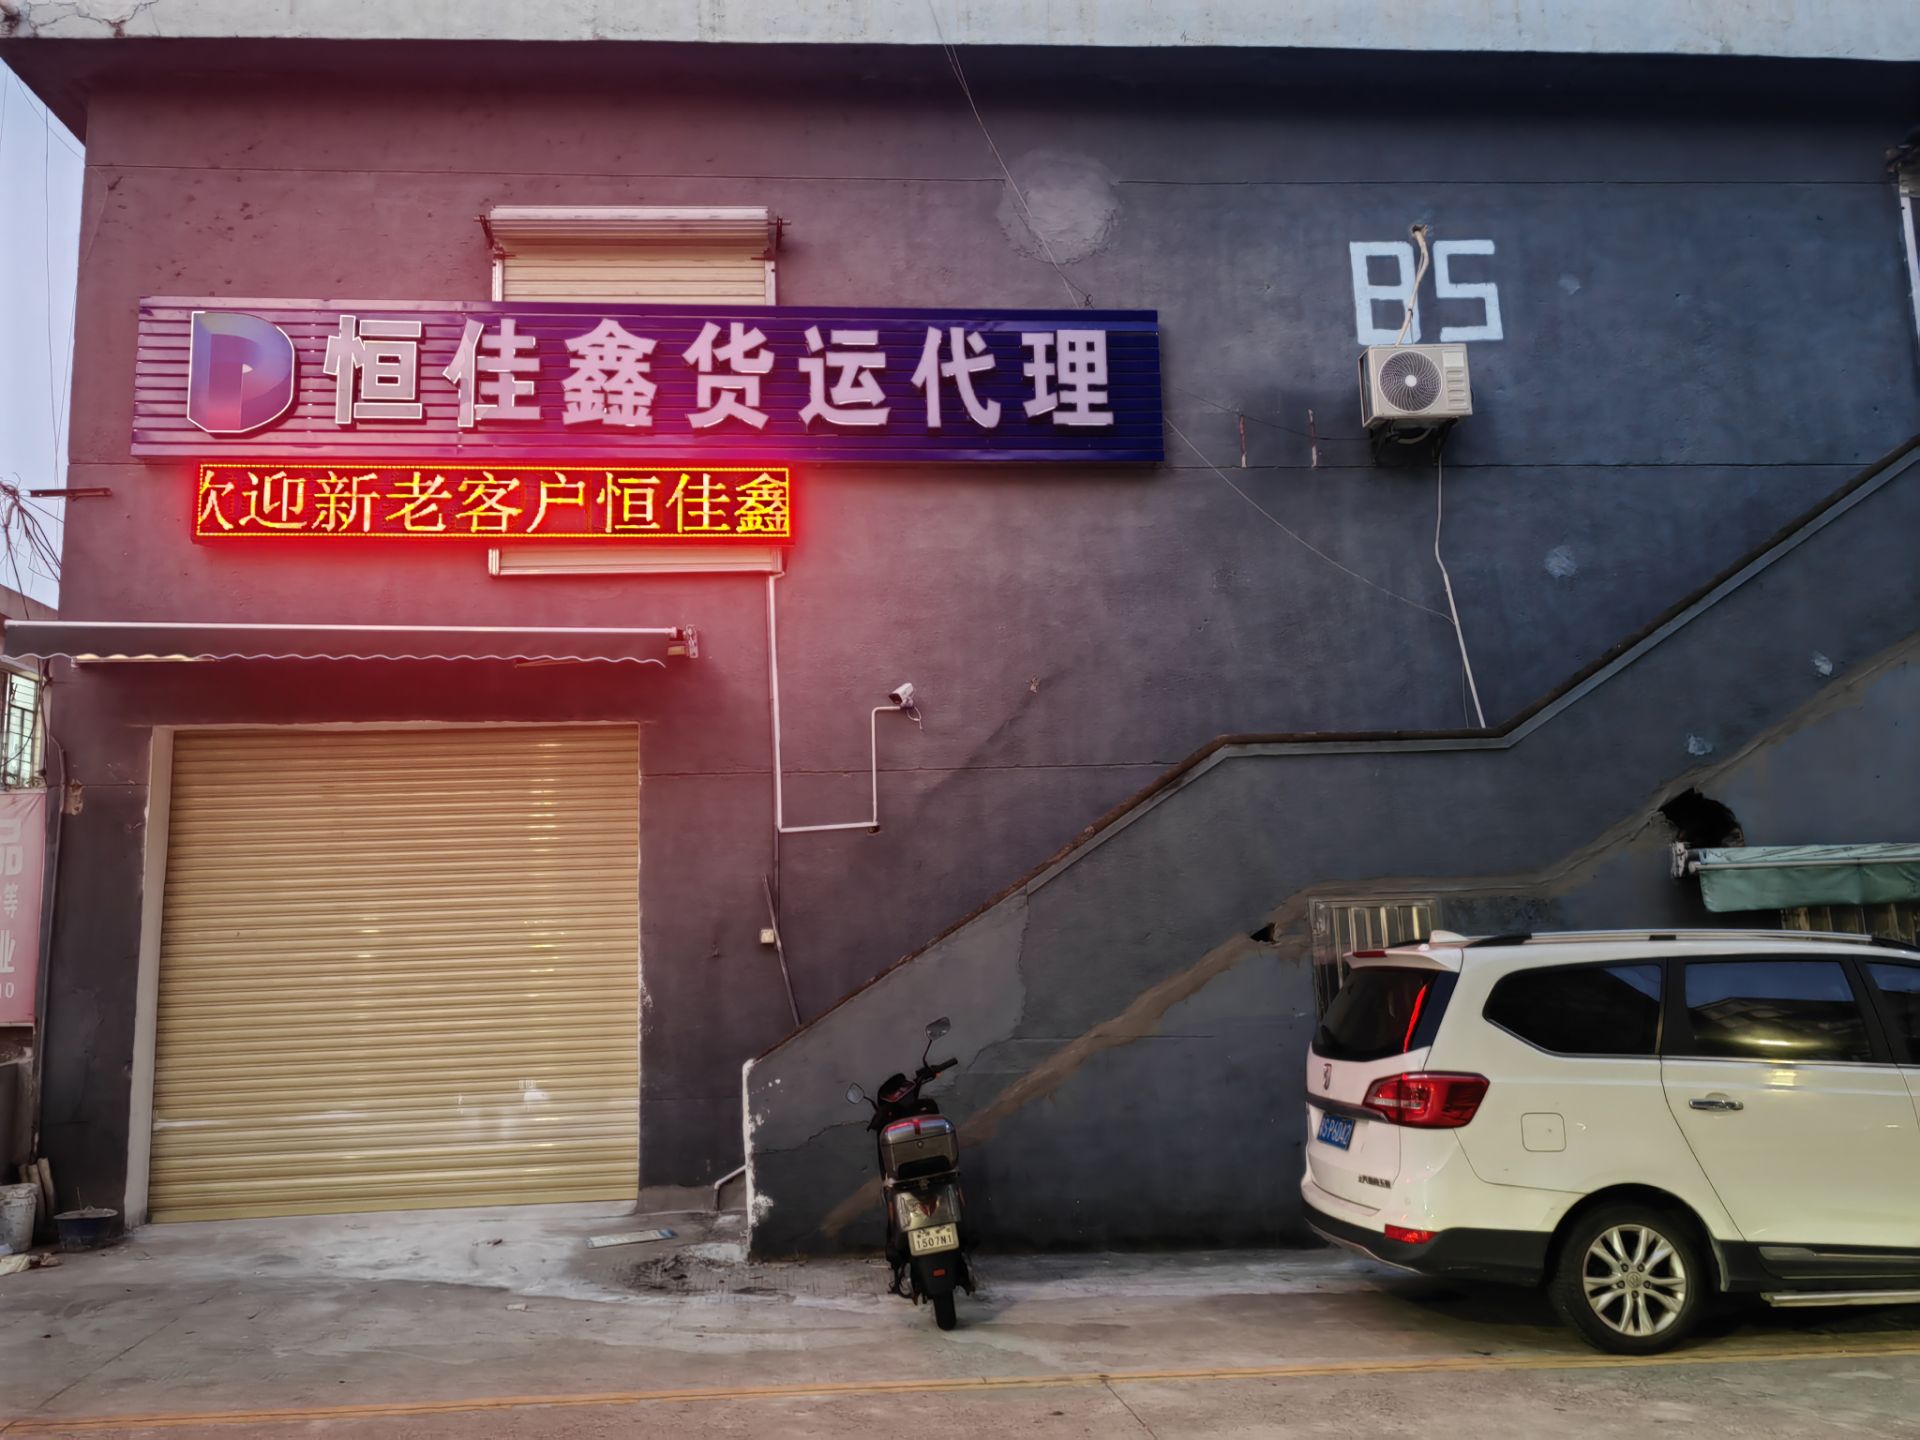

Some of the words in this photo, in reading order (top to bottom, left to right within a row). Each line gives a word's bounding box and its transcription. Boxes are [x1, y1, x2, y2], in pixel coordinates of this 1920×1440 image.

[323, 315, 1114, 428] 恒佳鑫货运代理
